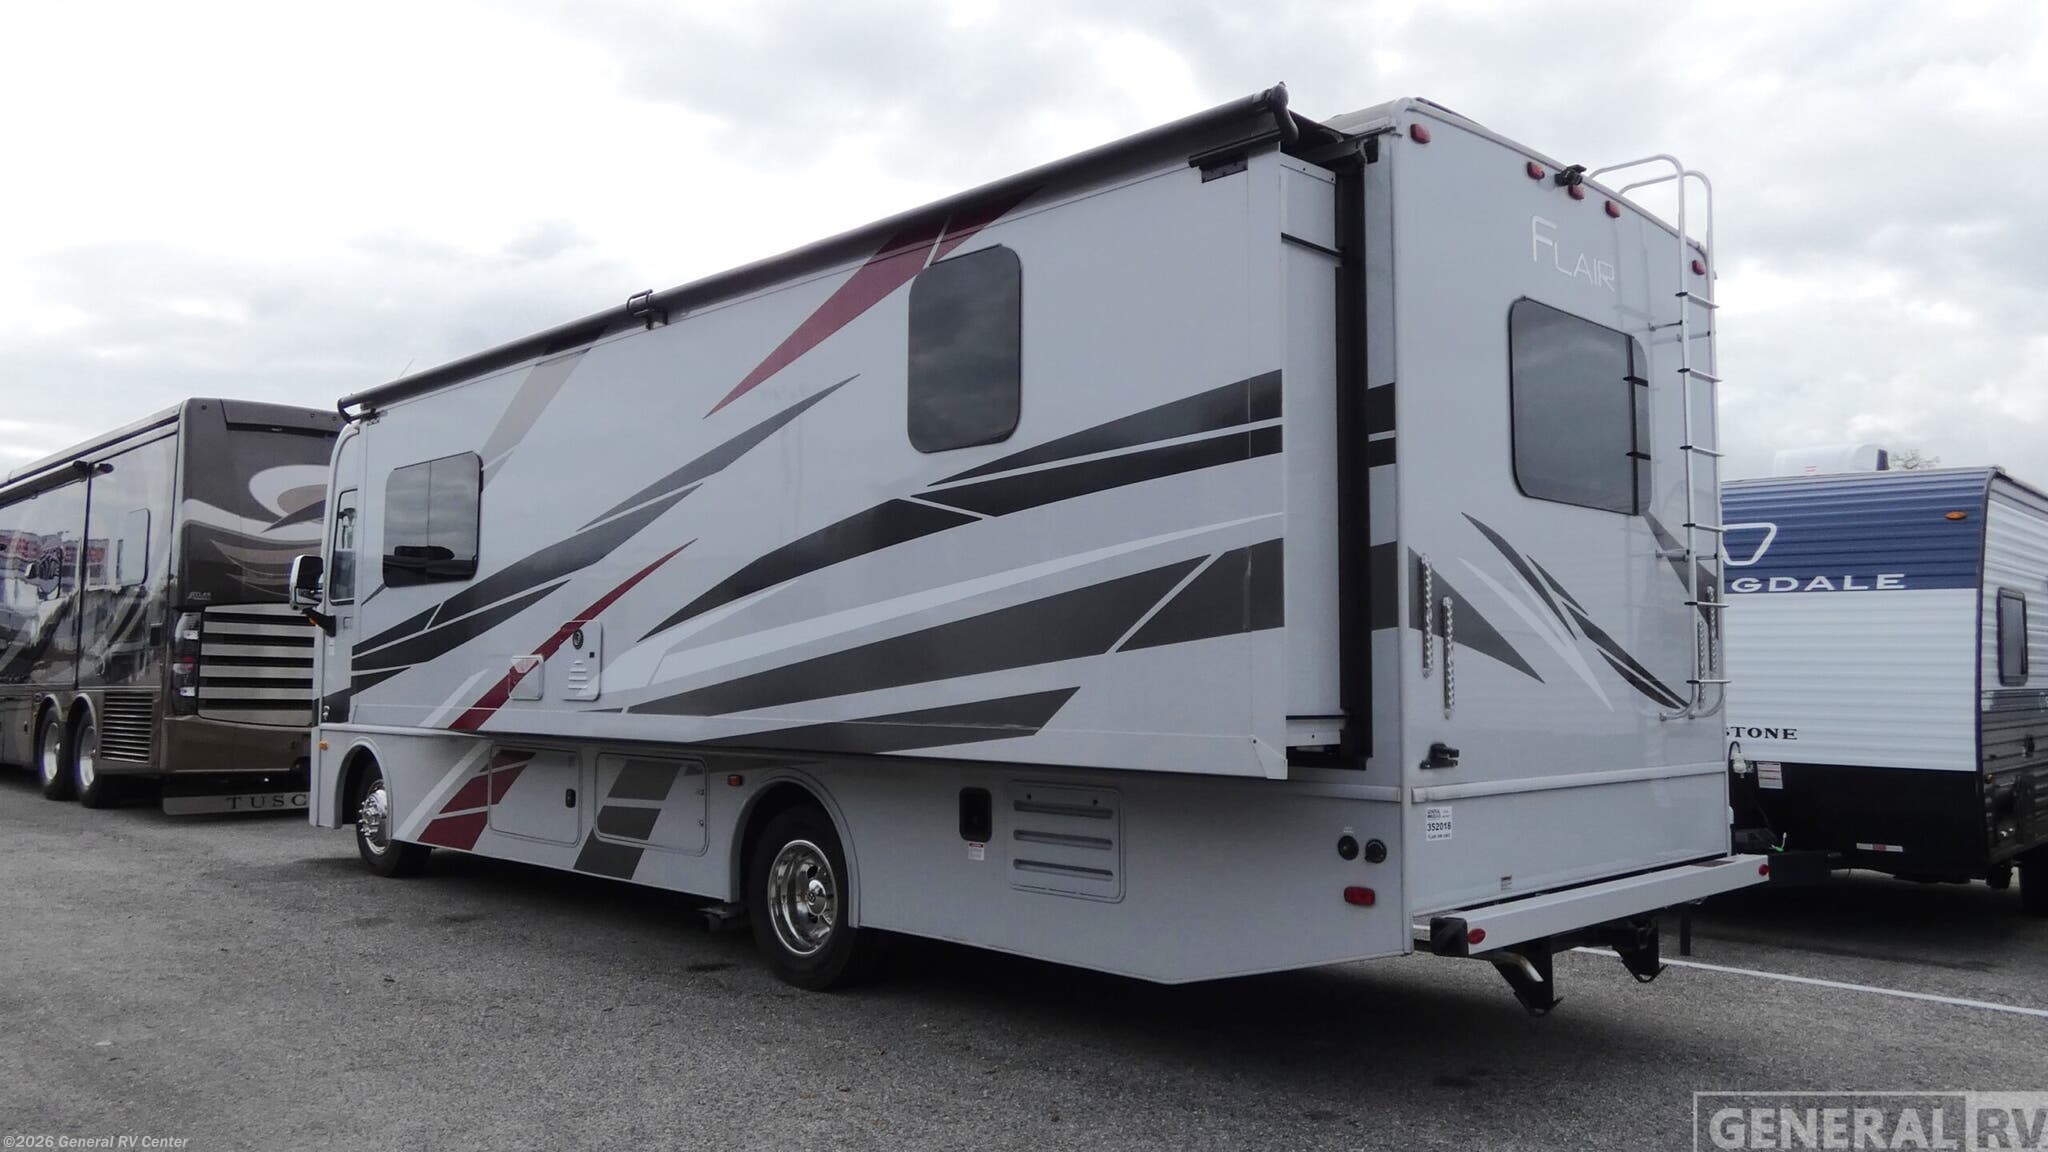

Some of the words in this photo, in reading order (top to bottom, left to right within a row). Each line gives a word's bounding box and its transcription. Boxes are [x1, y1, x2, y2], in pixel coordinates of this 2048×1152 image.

[1531, 215, 1615, 292] FLAIR
[1731, 573, 1906, 593] GDALE
[225, 793, 307, 810] TUSC
